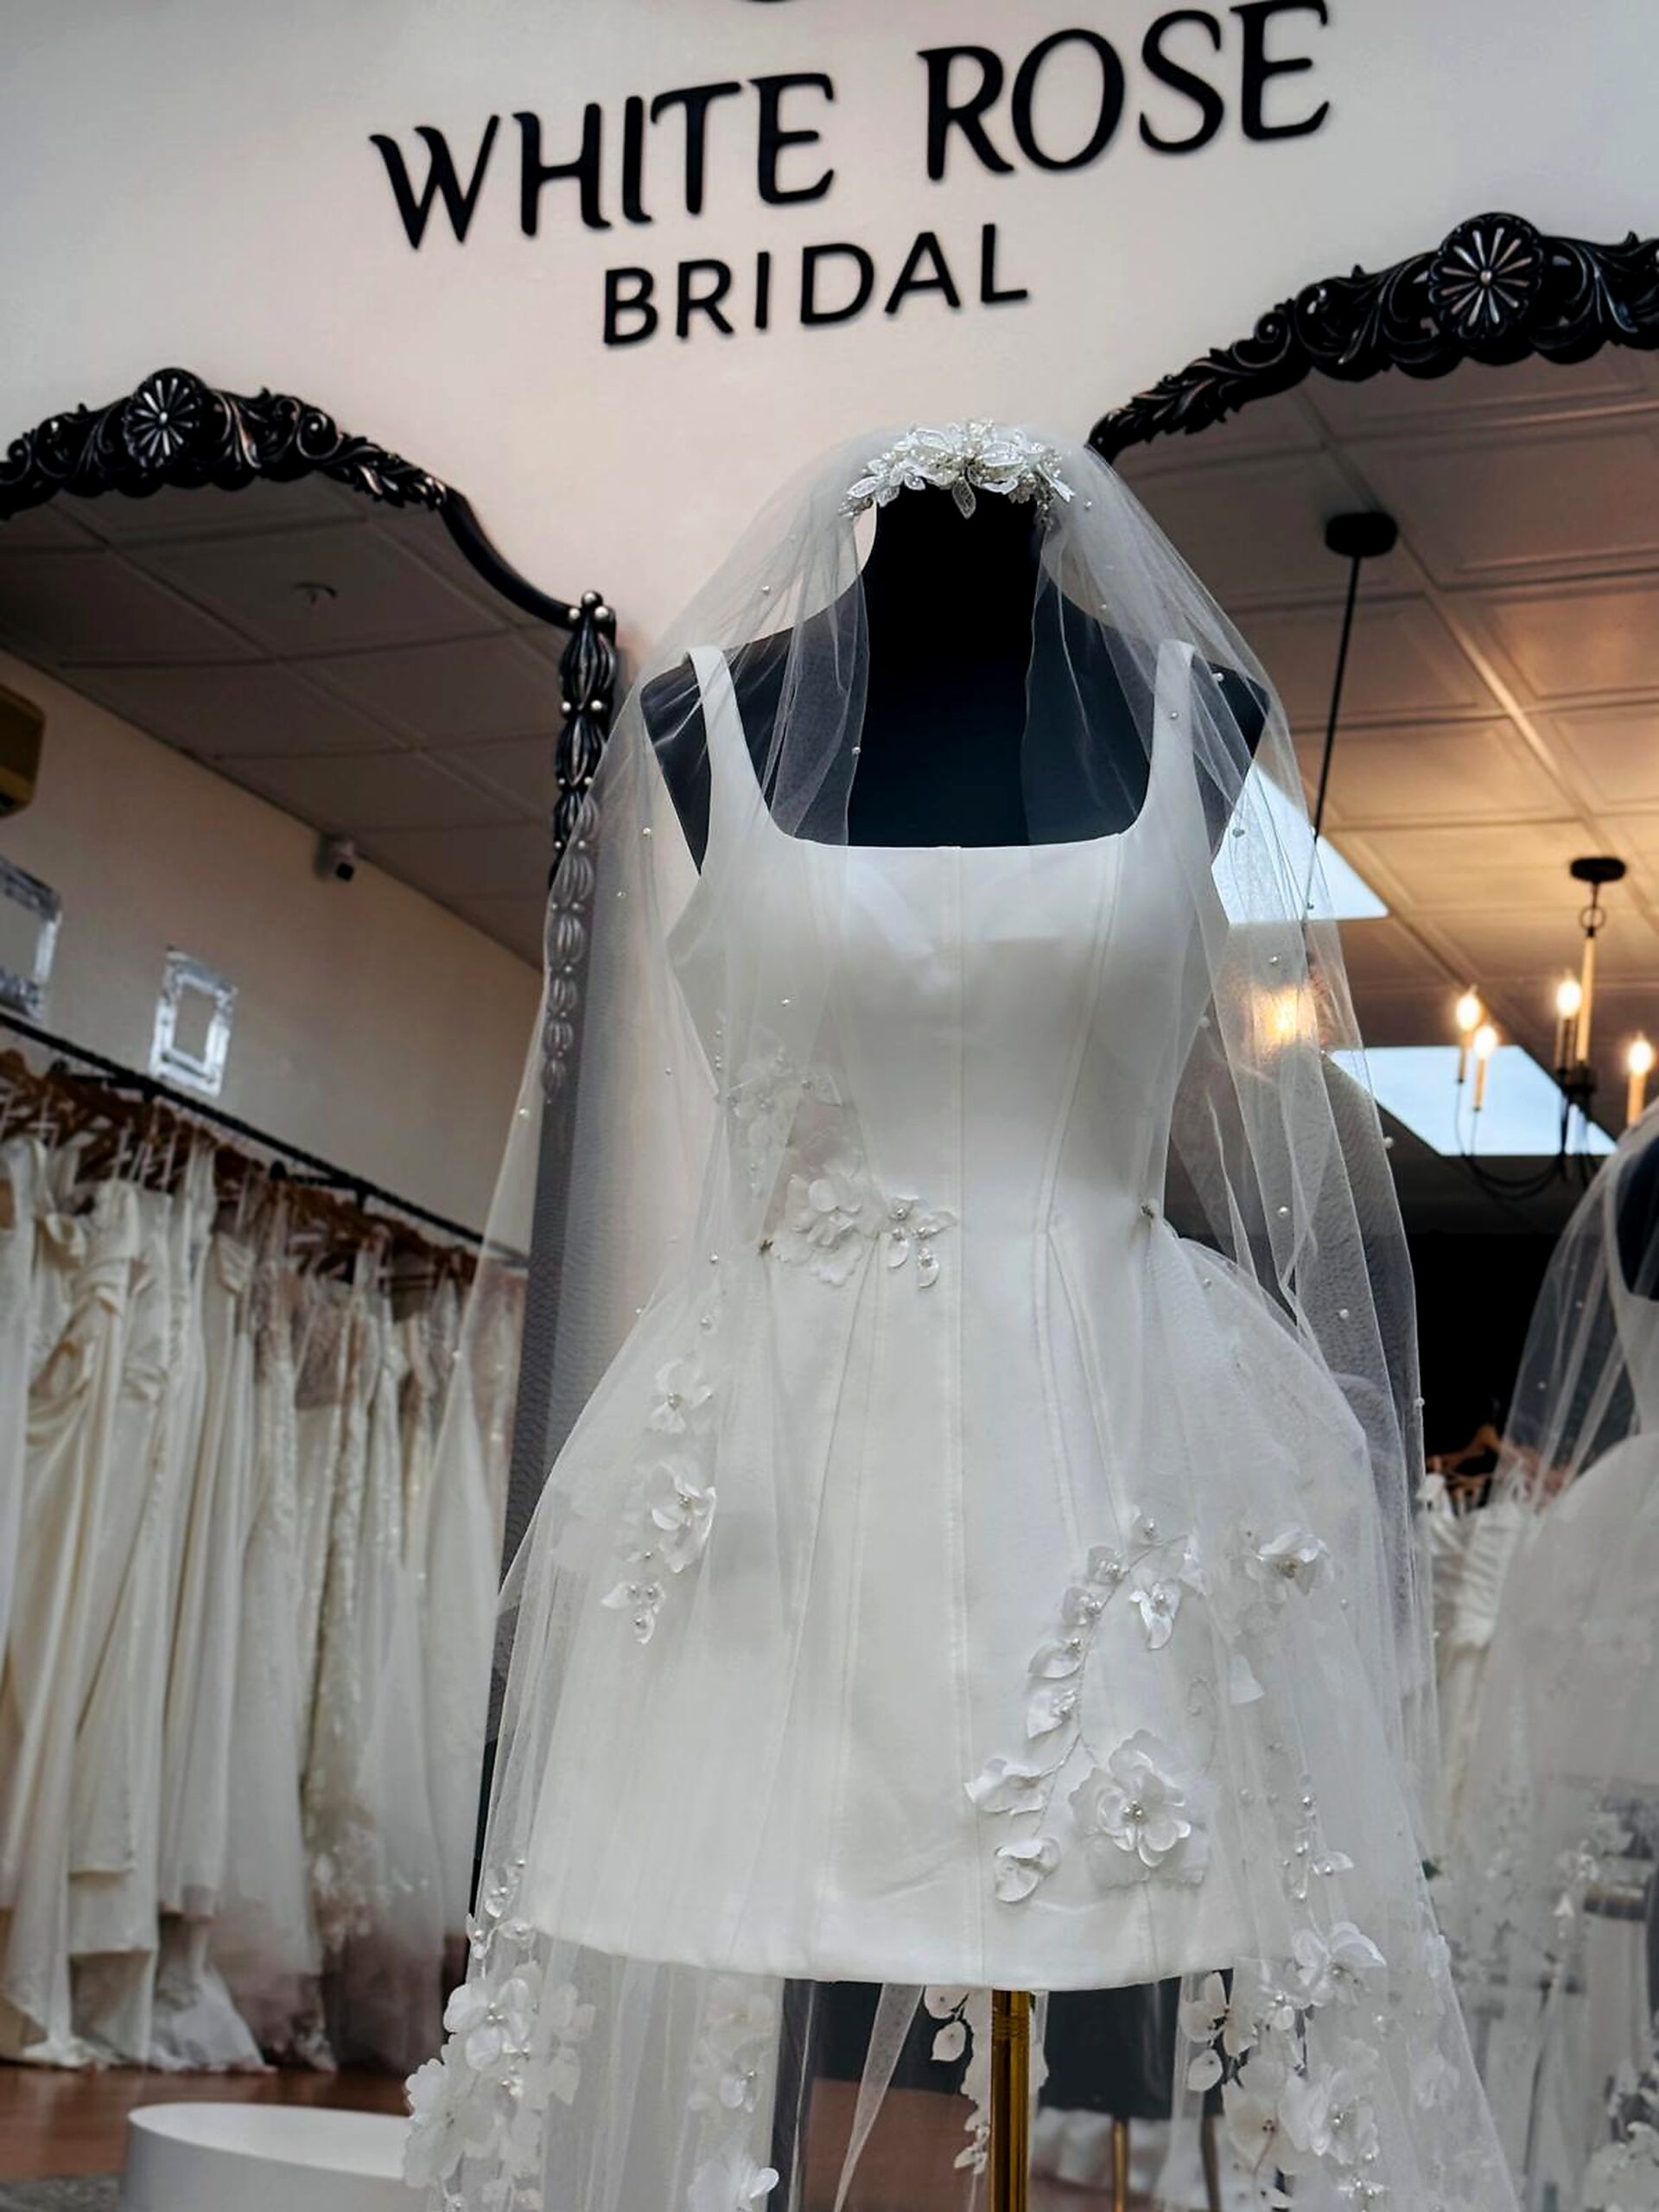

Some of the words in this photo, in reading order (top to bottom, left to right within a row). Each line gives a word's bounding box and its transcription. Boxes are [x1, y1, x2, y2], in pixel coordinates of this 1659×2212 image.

[369, 72, 836, 251] WHITE
[916, 0, 1331, 182] ROSE
[603, 223, 1030, 348] BRIDAL
